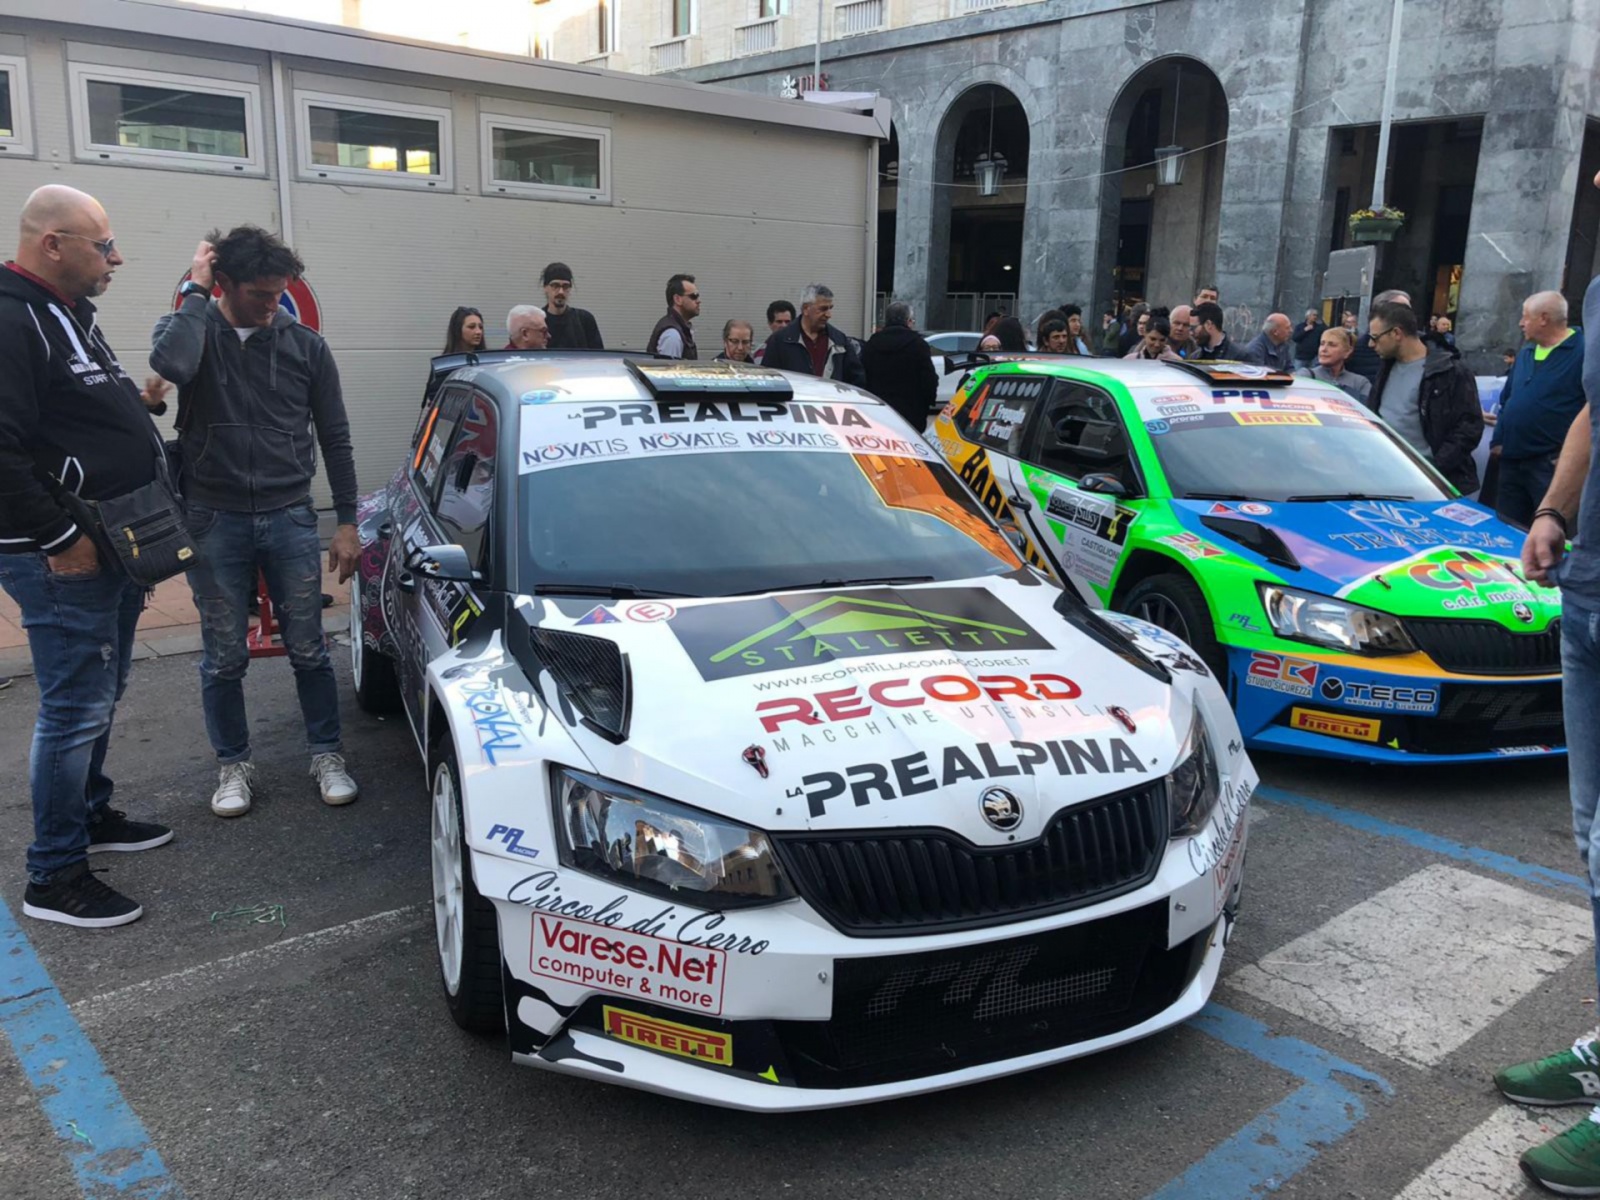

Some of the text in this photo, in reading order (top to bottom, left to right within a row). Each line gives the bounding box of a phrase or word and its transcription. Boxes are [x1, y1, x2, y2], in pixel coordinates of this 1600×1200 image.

[583, 401, 872, 430] PREALPINA
[969, 384, 990, 428] 4
[1238, 411, 1315, 424] PIRELLI
[1271, 403, 1315, 411] RACING
[1146, 421, 1168, 432] SD
[523, 438, 630, 466] NOVATIS
[639, 431, 739, 451] NOVATIS
[747, 431, 839, 448] NOVATIS
[845, 433, 930, 457] NOVATIS
[1106, 512, 1124, 541] 4
[741, 629, 1010, 667] STALLETTI
[754, 673, 1082, 735] RECORD
[1246, 676, 1312, 696] STUDIO SICUREZZA
[1347, 683, 1436, 704] TECO
[772, 703, 1105, 753] MACCHINE UTENSILI
[1299, 713, 1371, 737] PIRELLI
[785, 737, 1148, 819] LA PREALPINA
[507, 870, 771, 956] Circolo di Cerro
[539, 917, 718, 986] Varese.Net
[537, 956, 714, 1009] computer & more
[607, 1009, 727, 1061] PIRELLI
